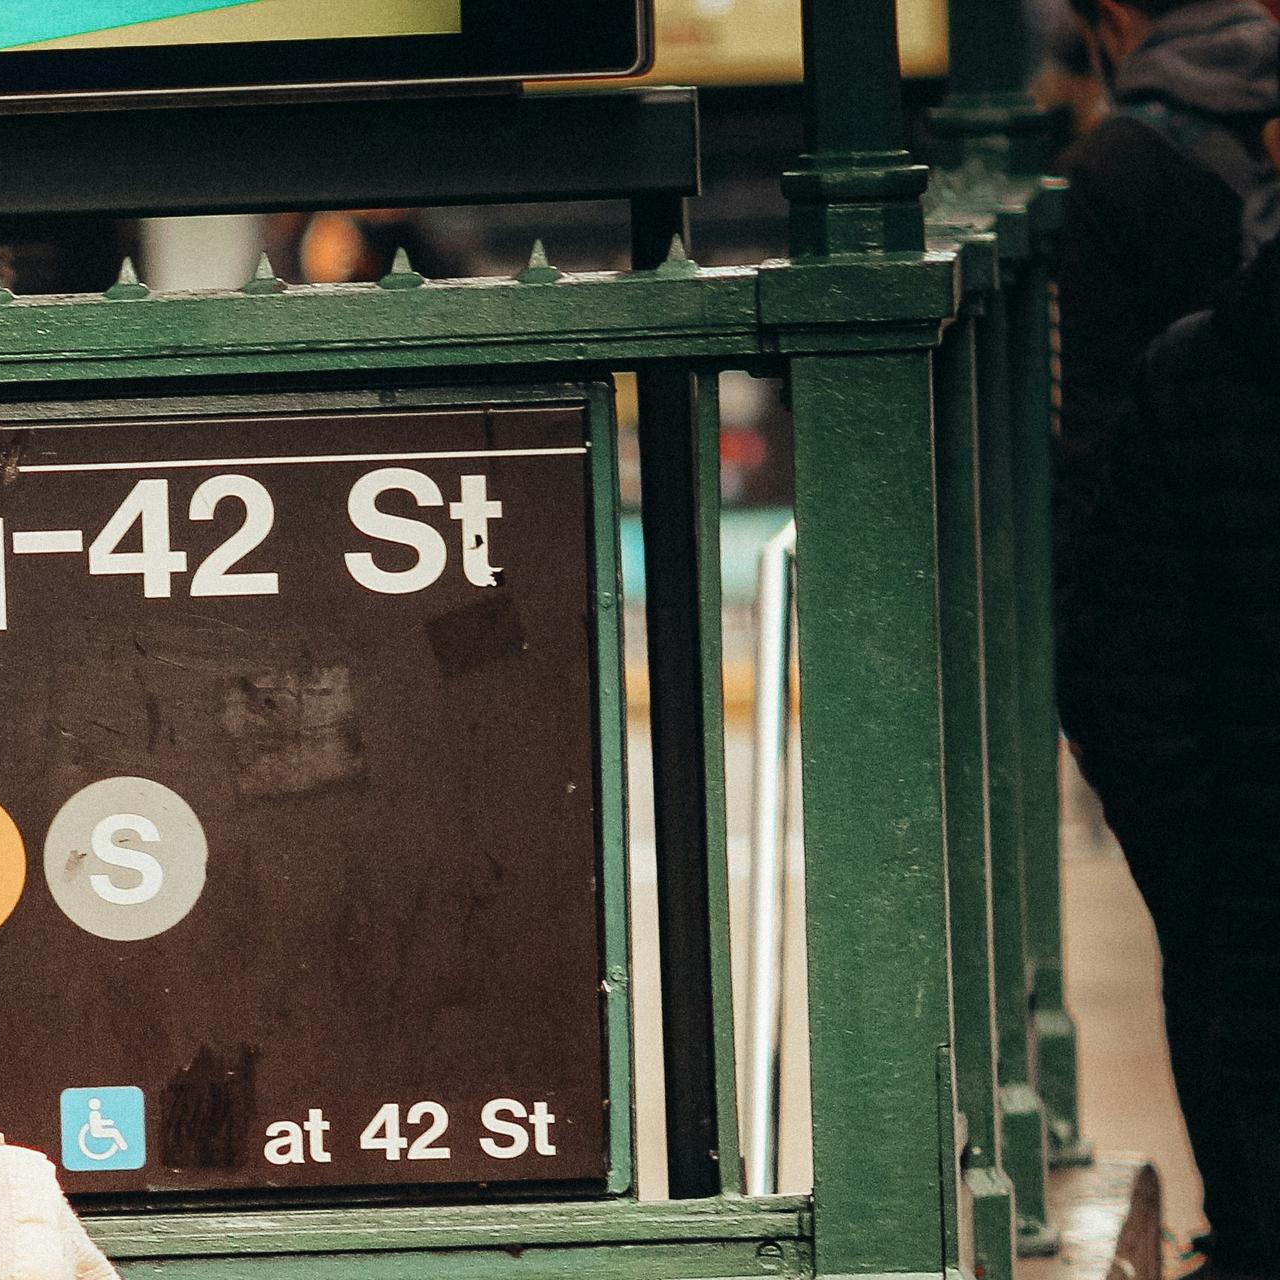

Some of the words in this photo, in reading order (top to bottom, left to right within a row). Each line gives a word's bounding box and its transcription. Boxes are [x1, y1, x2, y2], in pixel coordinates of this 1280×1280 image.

[344, 467, 504, 594] St
[89, 813, 164, 906] S
[263, 1108, 332, 1165] at
[359, 1100, 451, 1161] 42
[479, 1098, 557, 1159] St
